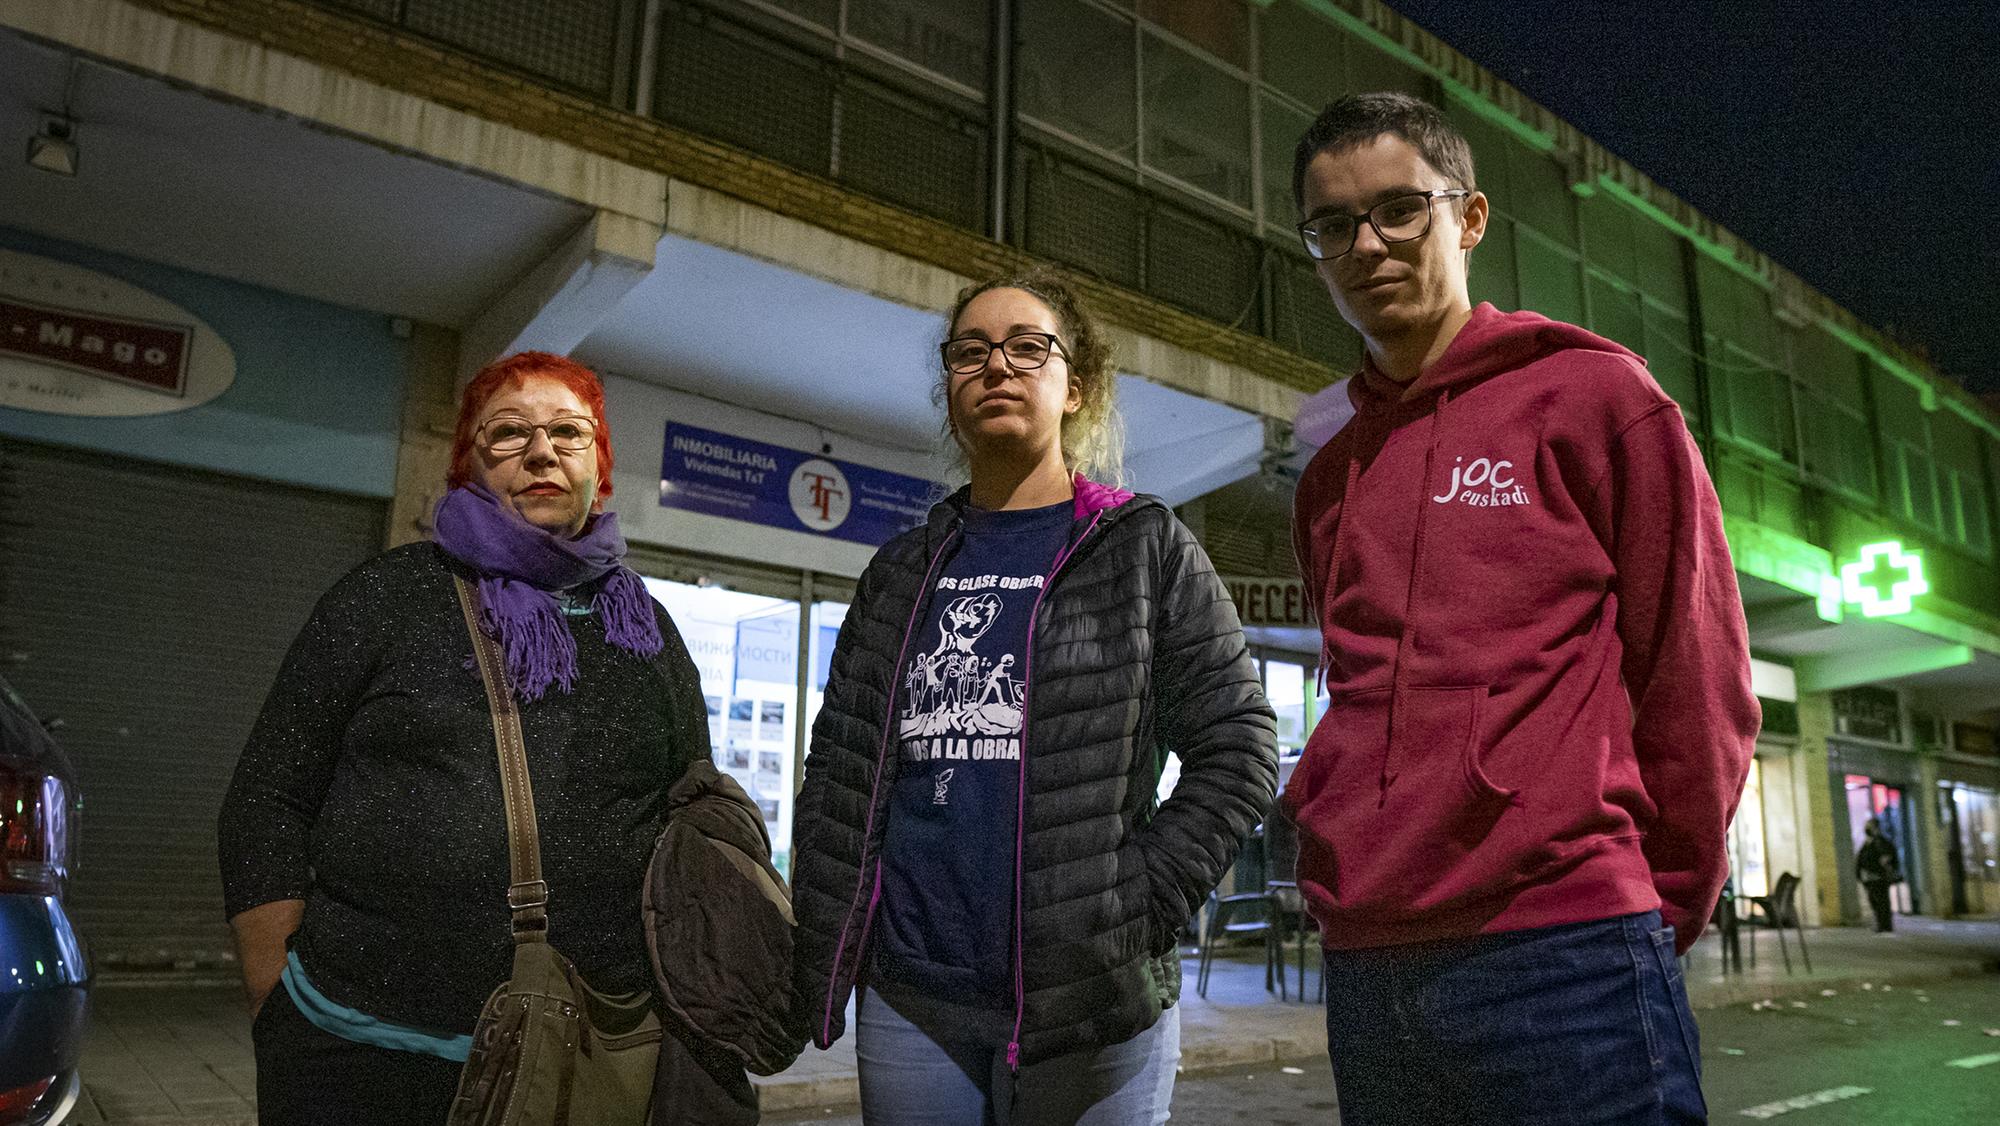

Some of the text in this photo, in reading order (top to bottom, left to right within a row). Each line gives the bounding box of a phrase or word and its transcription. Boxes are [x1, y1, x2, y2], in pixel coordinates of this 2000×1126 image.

[673, 435, 778, 472] INMOBILIARIA
[684, 455, 742, 479] Viviendas
[1459, 485, 1531, 507] euskadi
[936, 574, 1045, 591] OS CLASE OBRER
[687, 637, 791, 665] ВИЖИМОСТИ
[930, 737, 942, 760] A
[945, 737, 968, 760] LA
[972, 738, 1021, 760] OBRA
